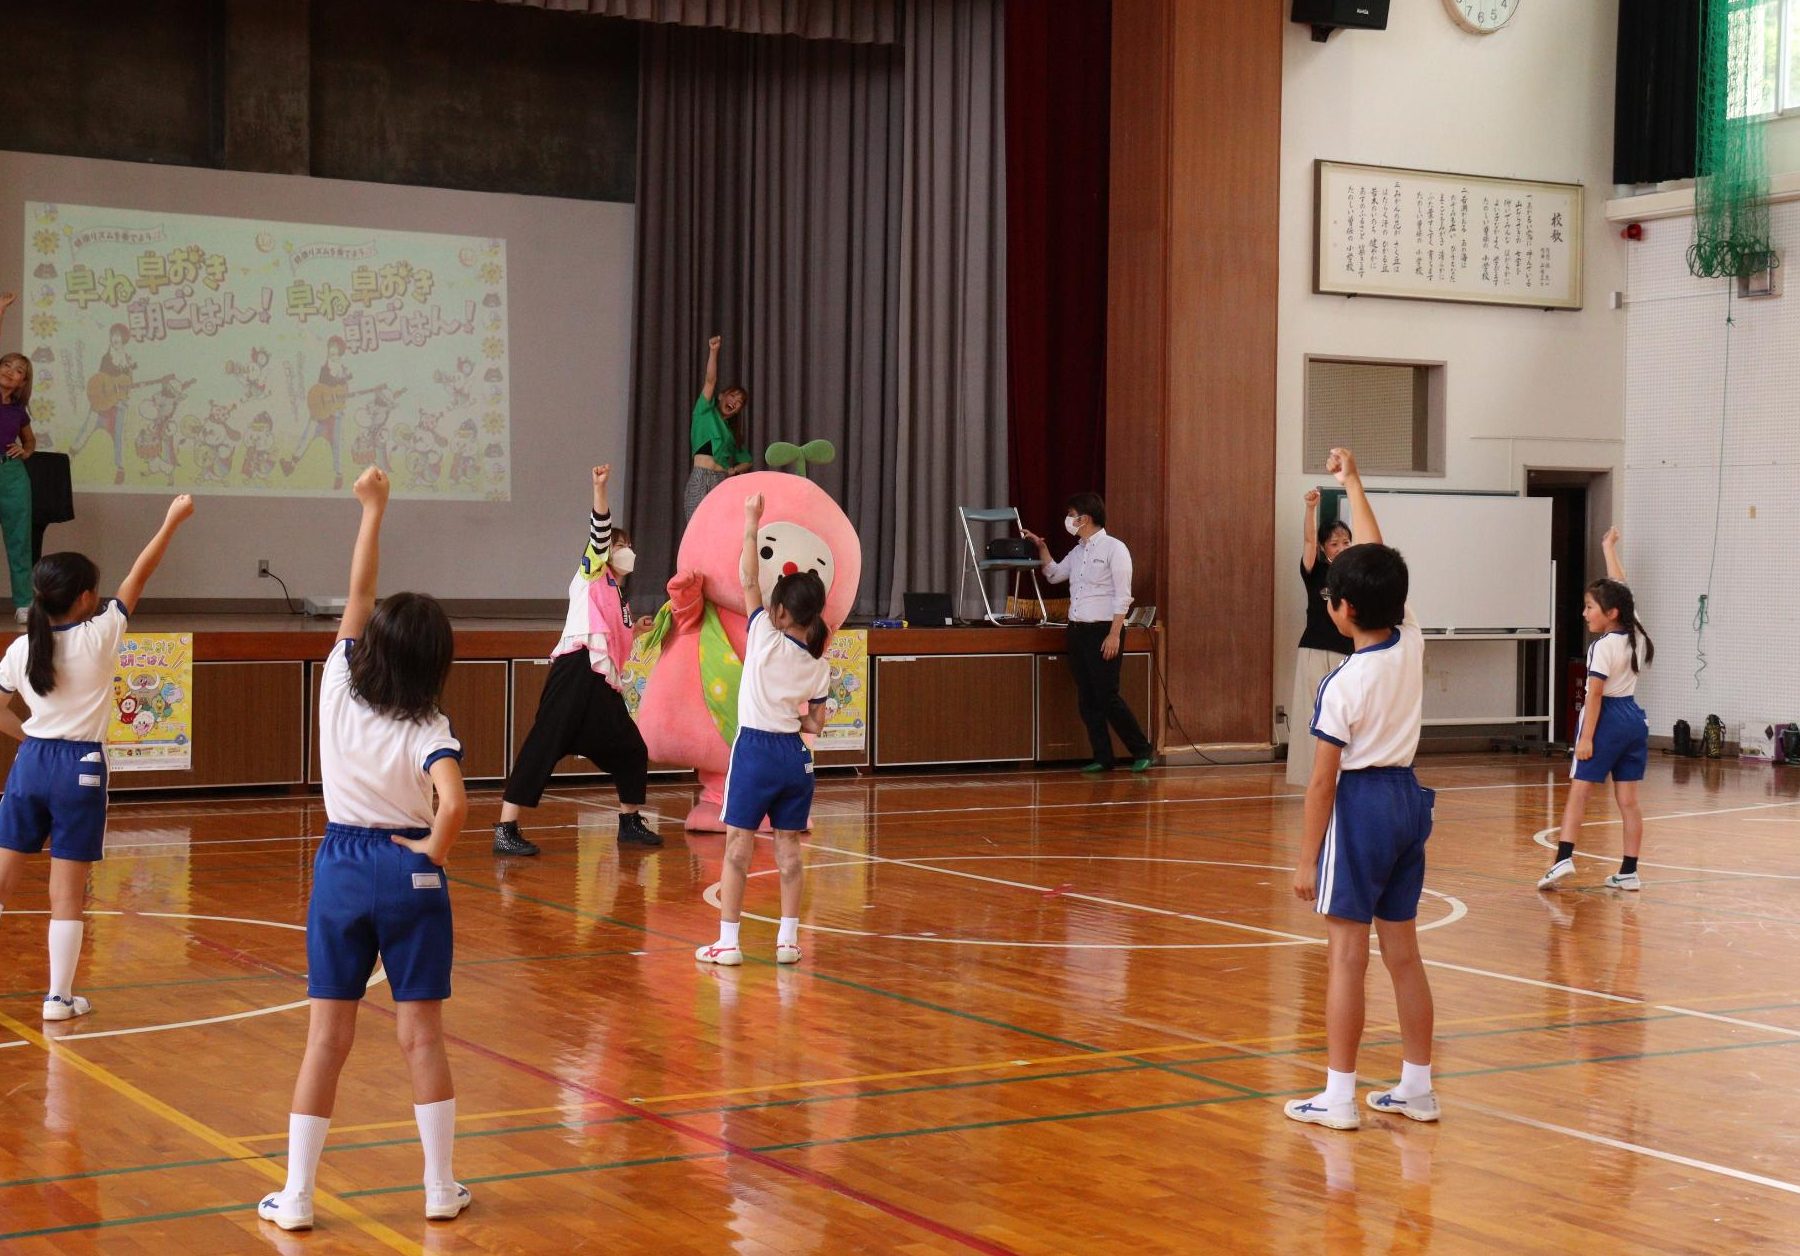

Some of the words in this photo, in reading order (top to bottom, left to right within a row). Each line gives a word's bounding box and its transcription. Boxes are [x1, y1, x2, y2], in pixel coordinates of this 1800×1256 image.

[1465, 5, 1473, 17] 7
[1490, 8, 1498, 21] 5
[1477, 12, 1485, 24] 6
[1550, 211, 1564, 243] 校歌
